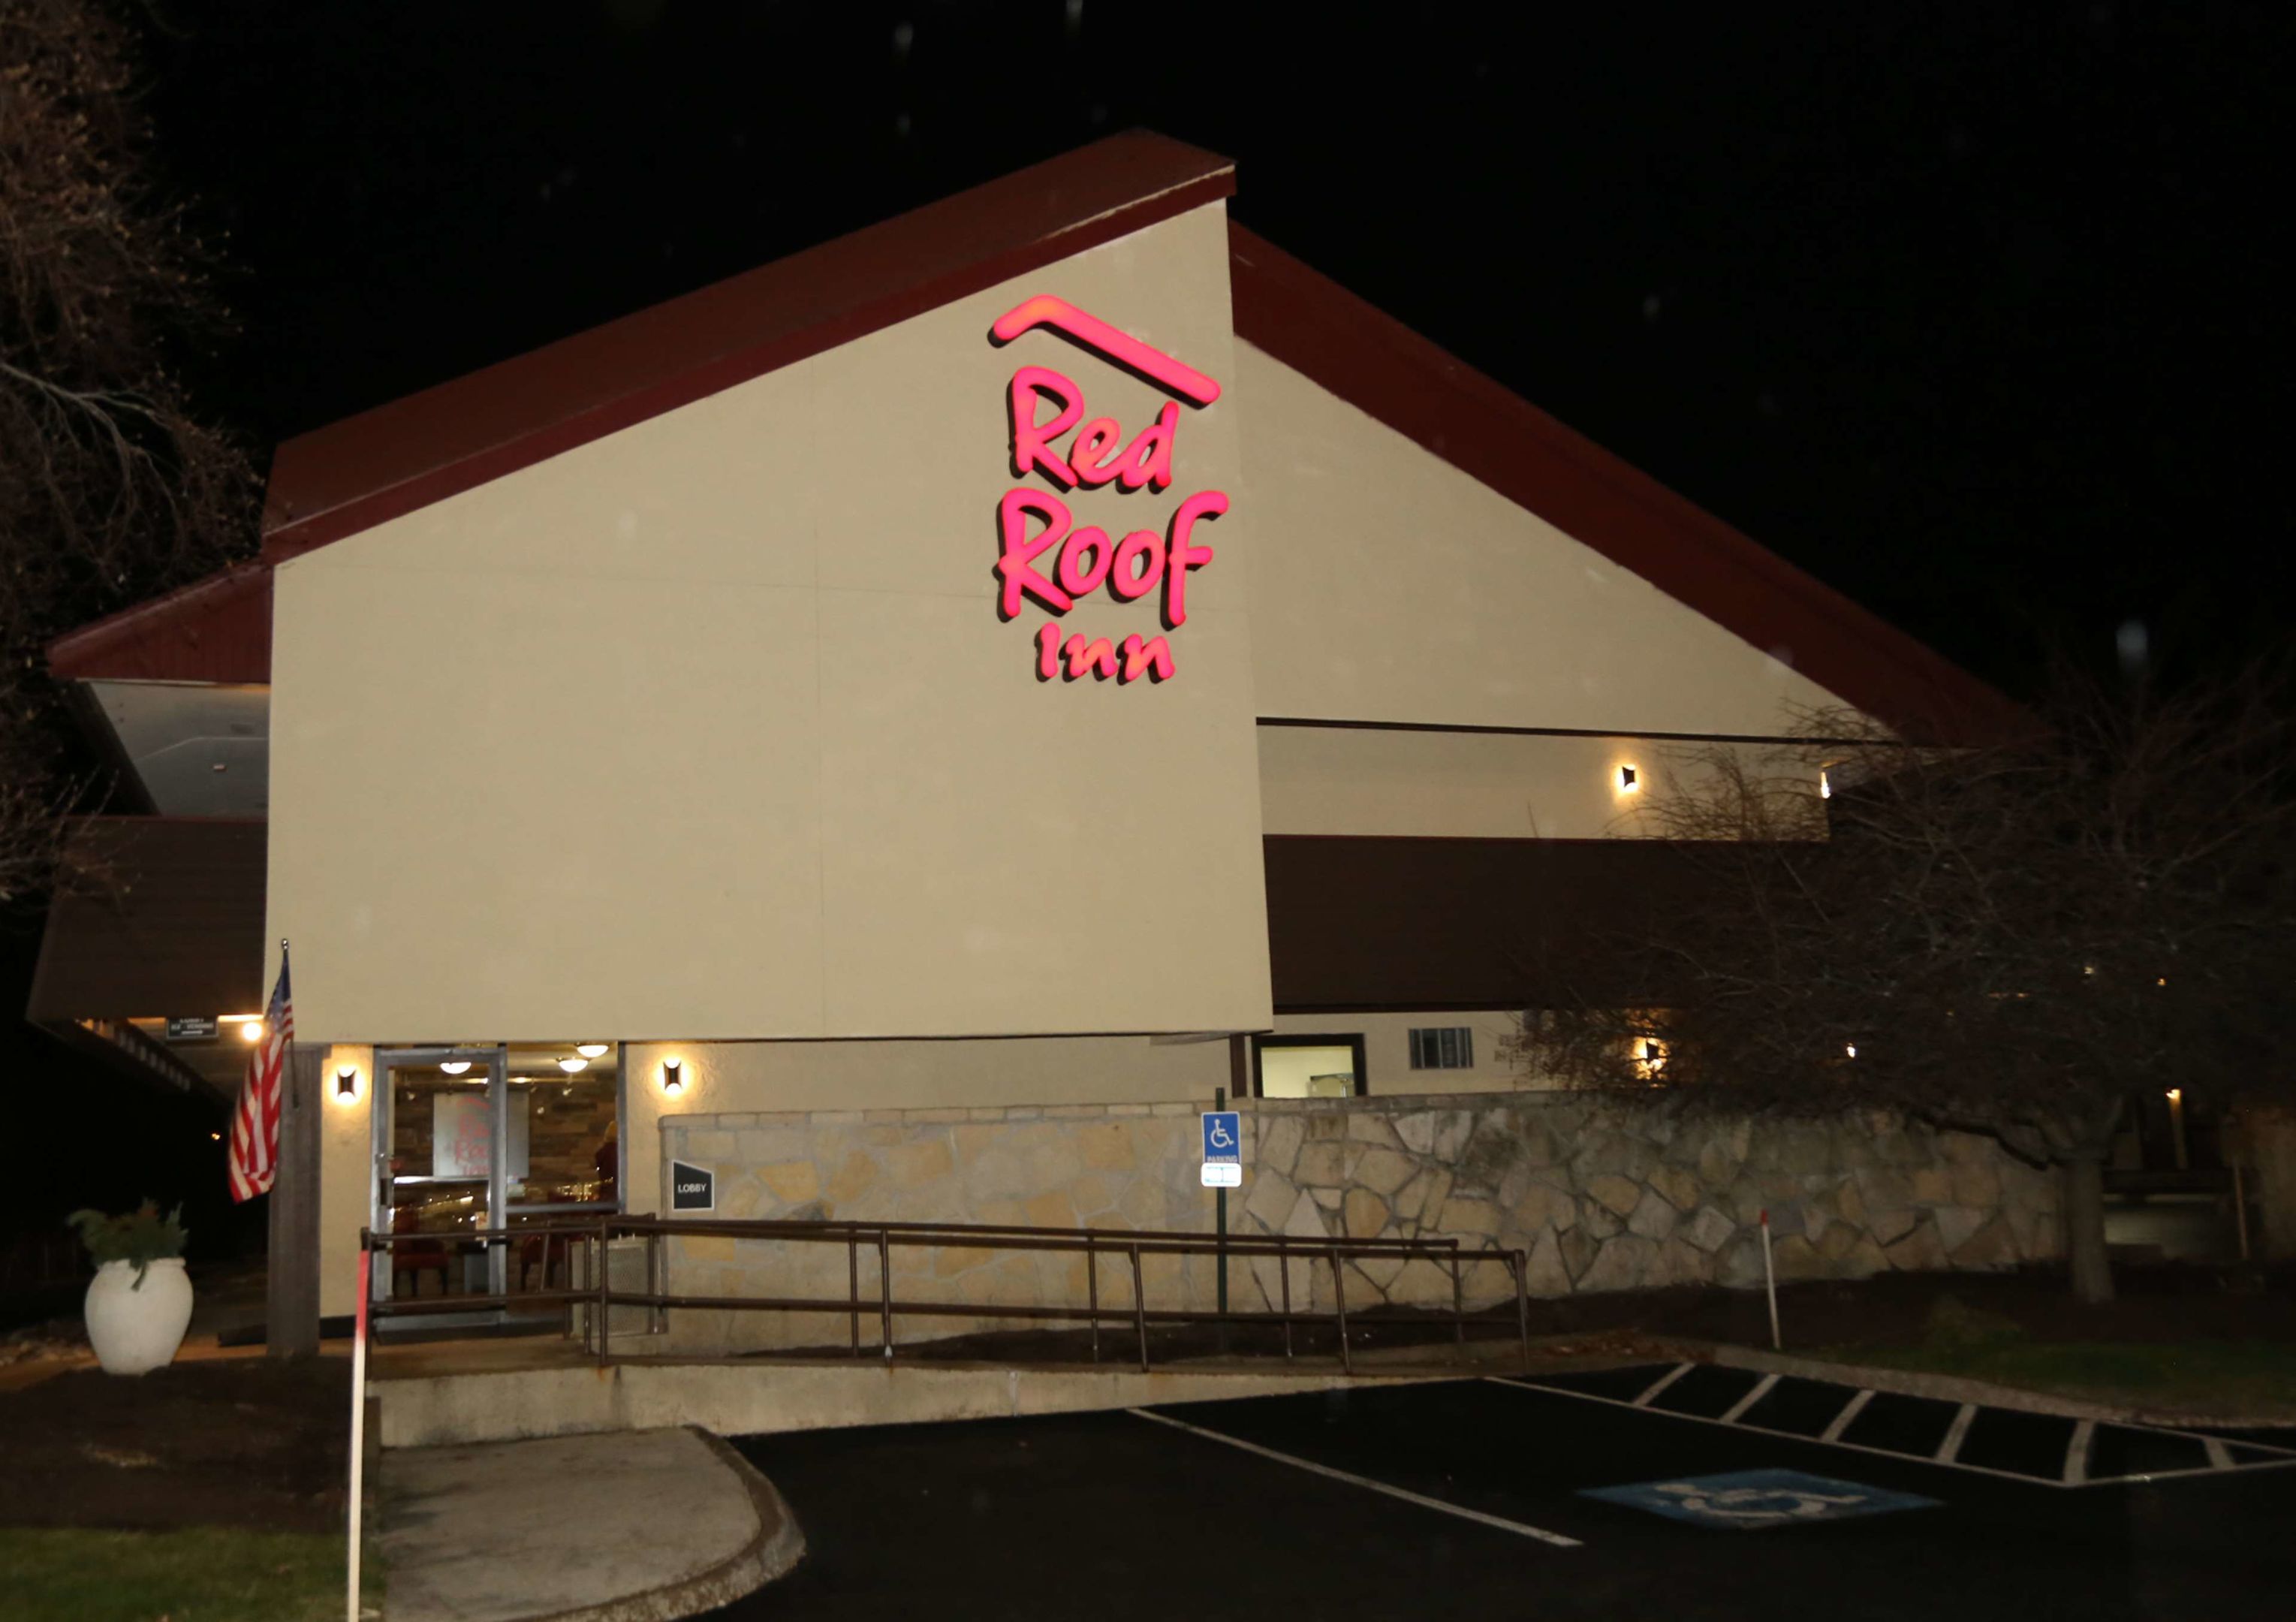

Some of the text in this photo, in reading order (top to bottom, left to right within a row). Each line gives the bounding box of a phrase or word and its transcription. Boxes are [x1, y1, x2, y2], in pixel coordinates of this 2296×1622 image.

[1007, 366, 1179, 493] Red
[995, 487, 1230, 629] Roof
[678, 1183, 707, 1193] LOBBY
